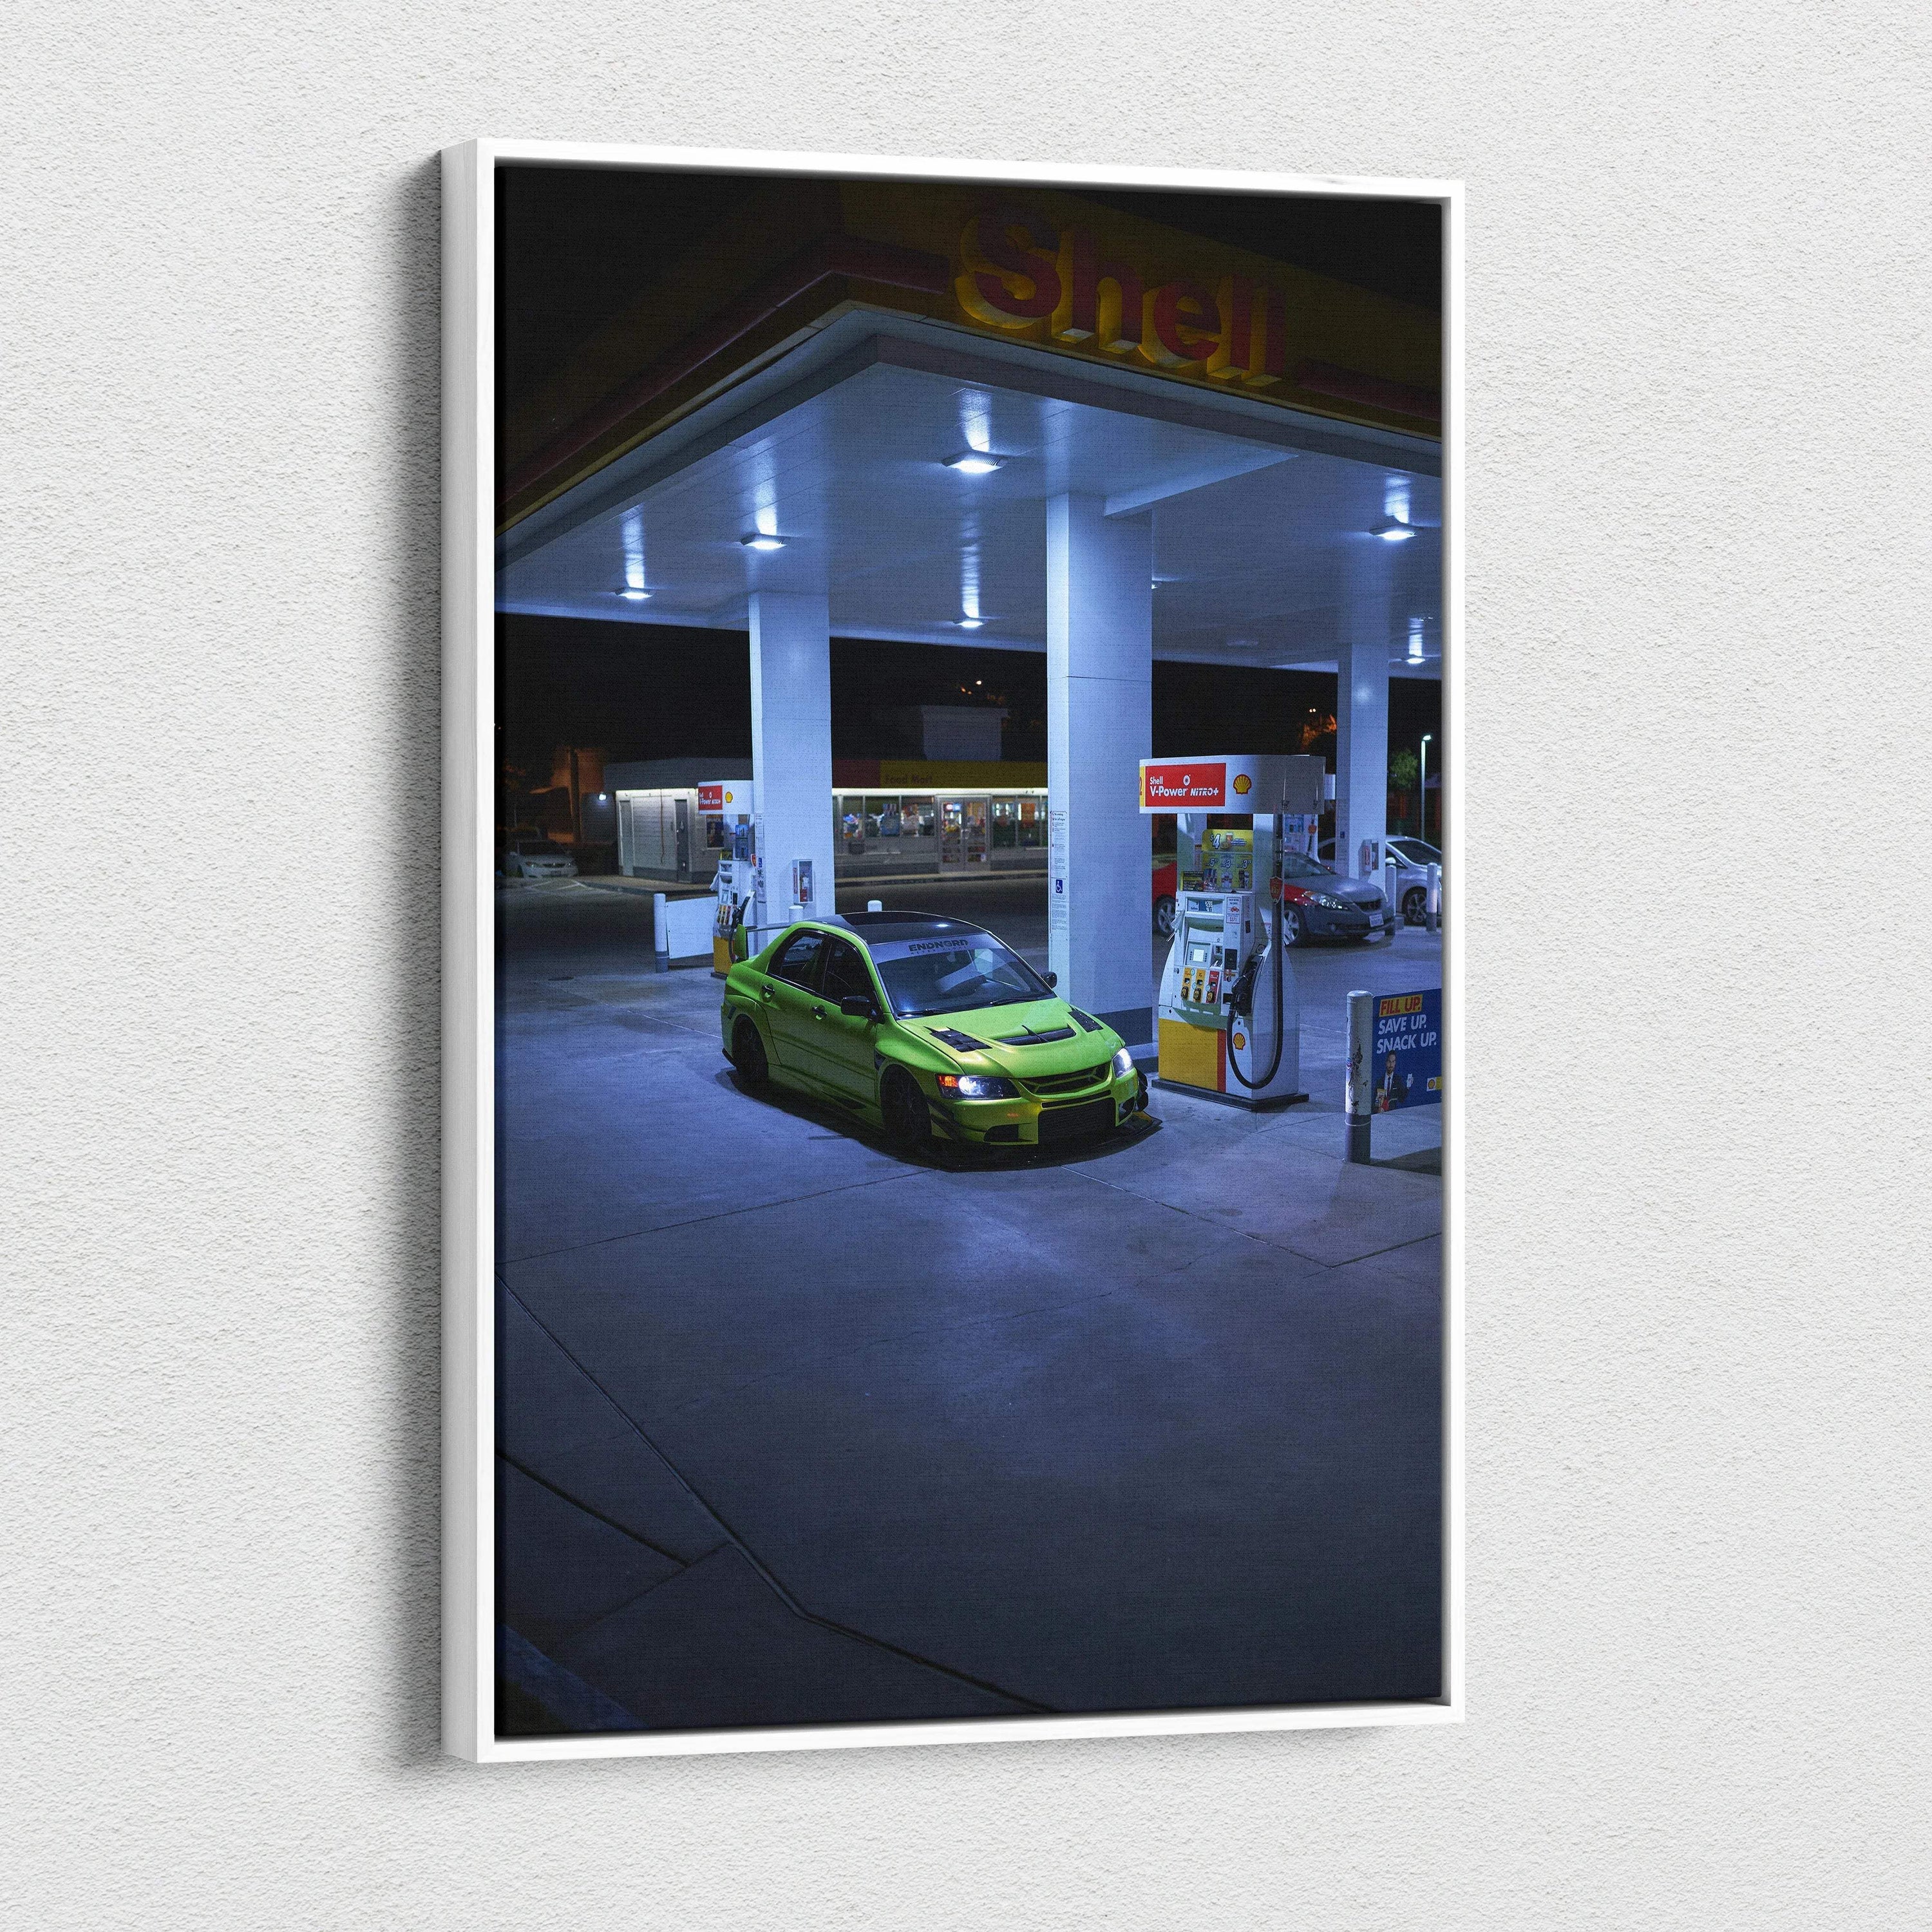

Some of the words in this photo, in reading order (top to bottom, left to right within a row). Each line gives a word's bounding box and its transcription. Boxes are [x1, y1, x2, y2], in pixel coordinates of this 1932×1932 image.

[956, 197, 1286, 386] Shell
[1150, 776, 1163, 785] Shell
[1150, 786, 1188, 797] V-Power
[1380, 998, 1401, 1016] FILL
[1405, 996, 1421, 1012] UP.
[1378, 1017, 1407, 1035] SAVE
[1410, 1014, 1426, 1030] UP.
[1376, 1034, 1417, 1054] SNACK
[1420, 1031, 1437, 1047] UP.
